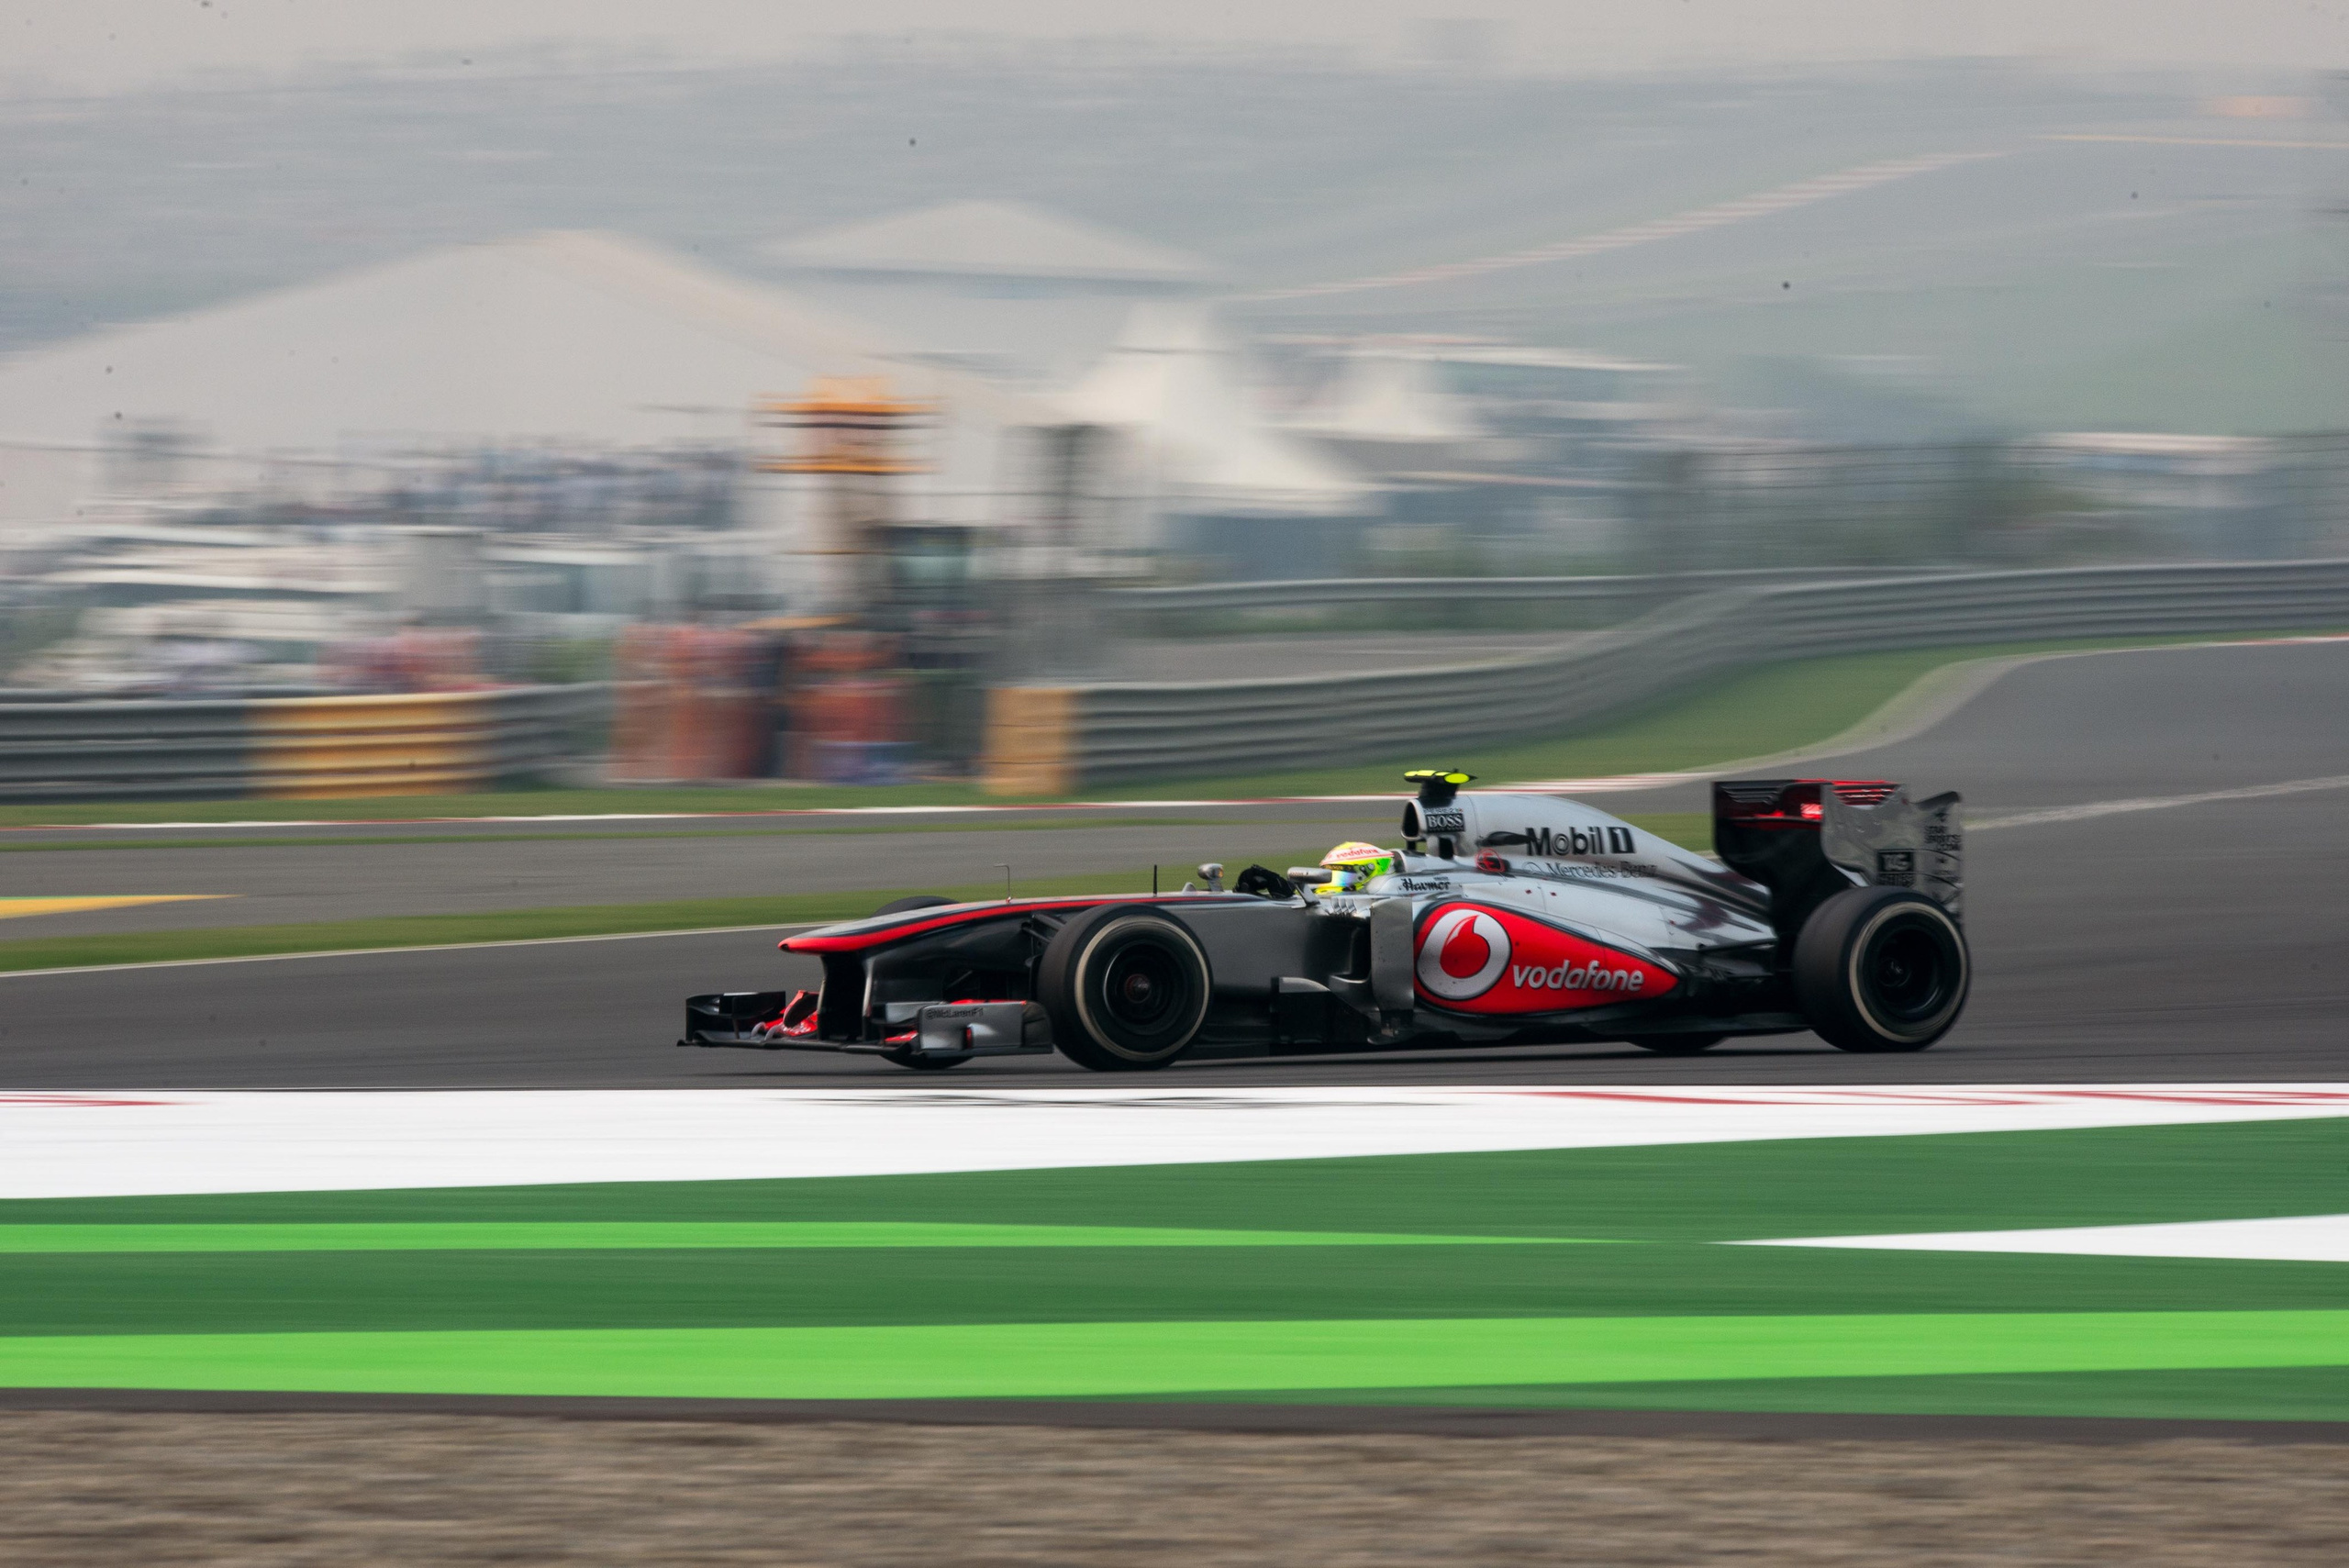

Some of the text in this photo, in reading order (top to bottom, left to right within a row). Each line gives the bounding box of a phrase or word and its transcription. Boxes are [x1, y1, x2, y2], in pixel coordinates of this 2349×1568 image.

[1427, 814, 1463, 828] BOSS
[1524, 826, 1632, 856] Mobil 1
[1513, 959, 1644, 992] vodafone
